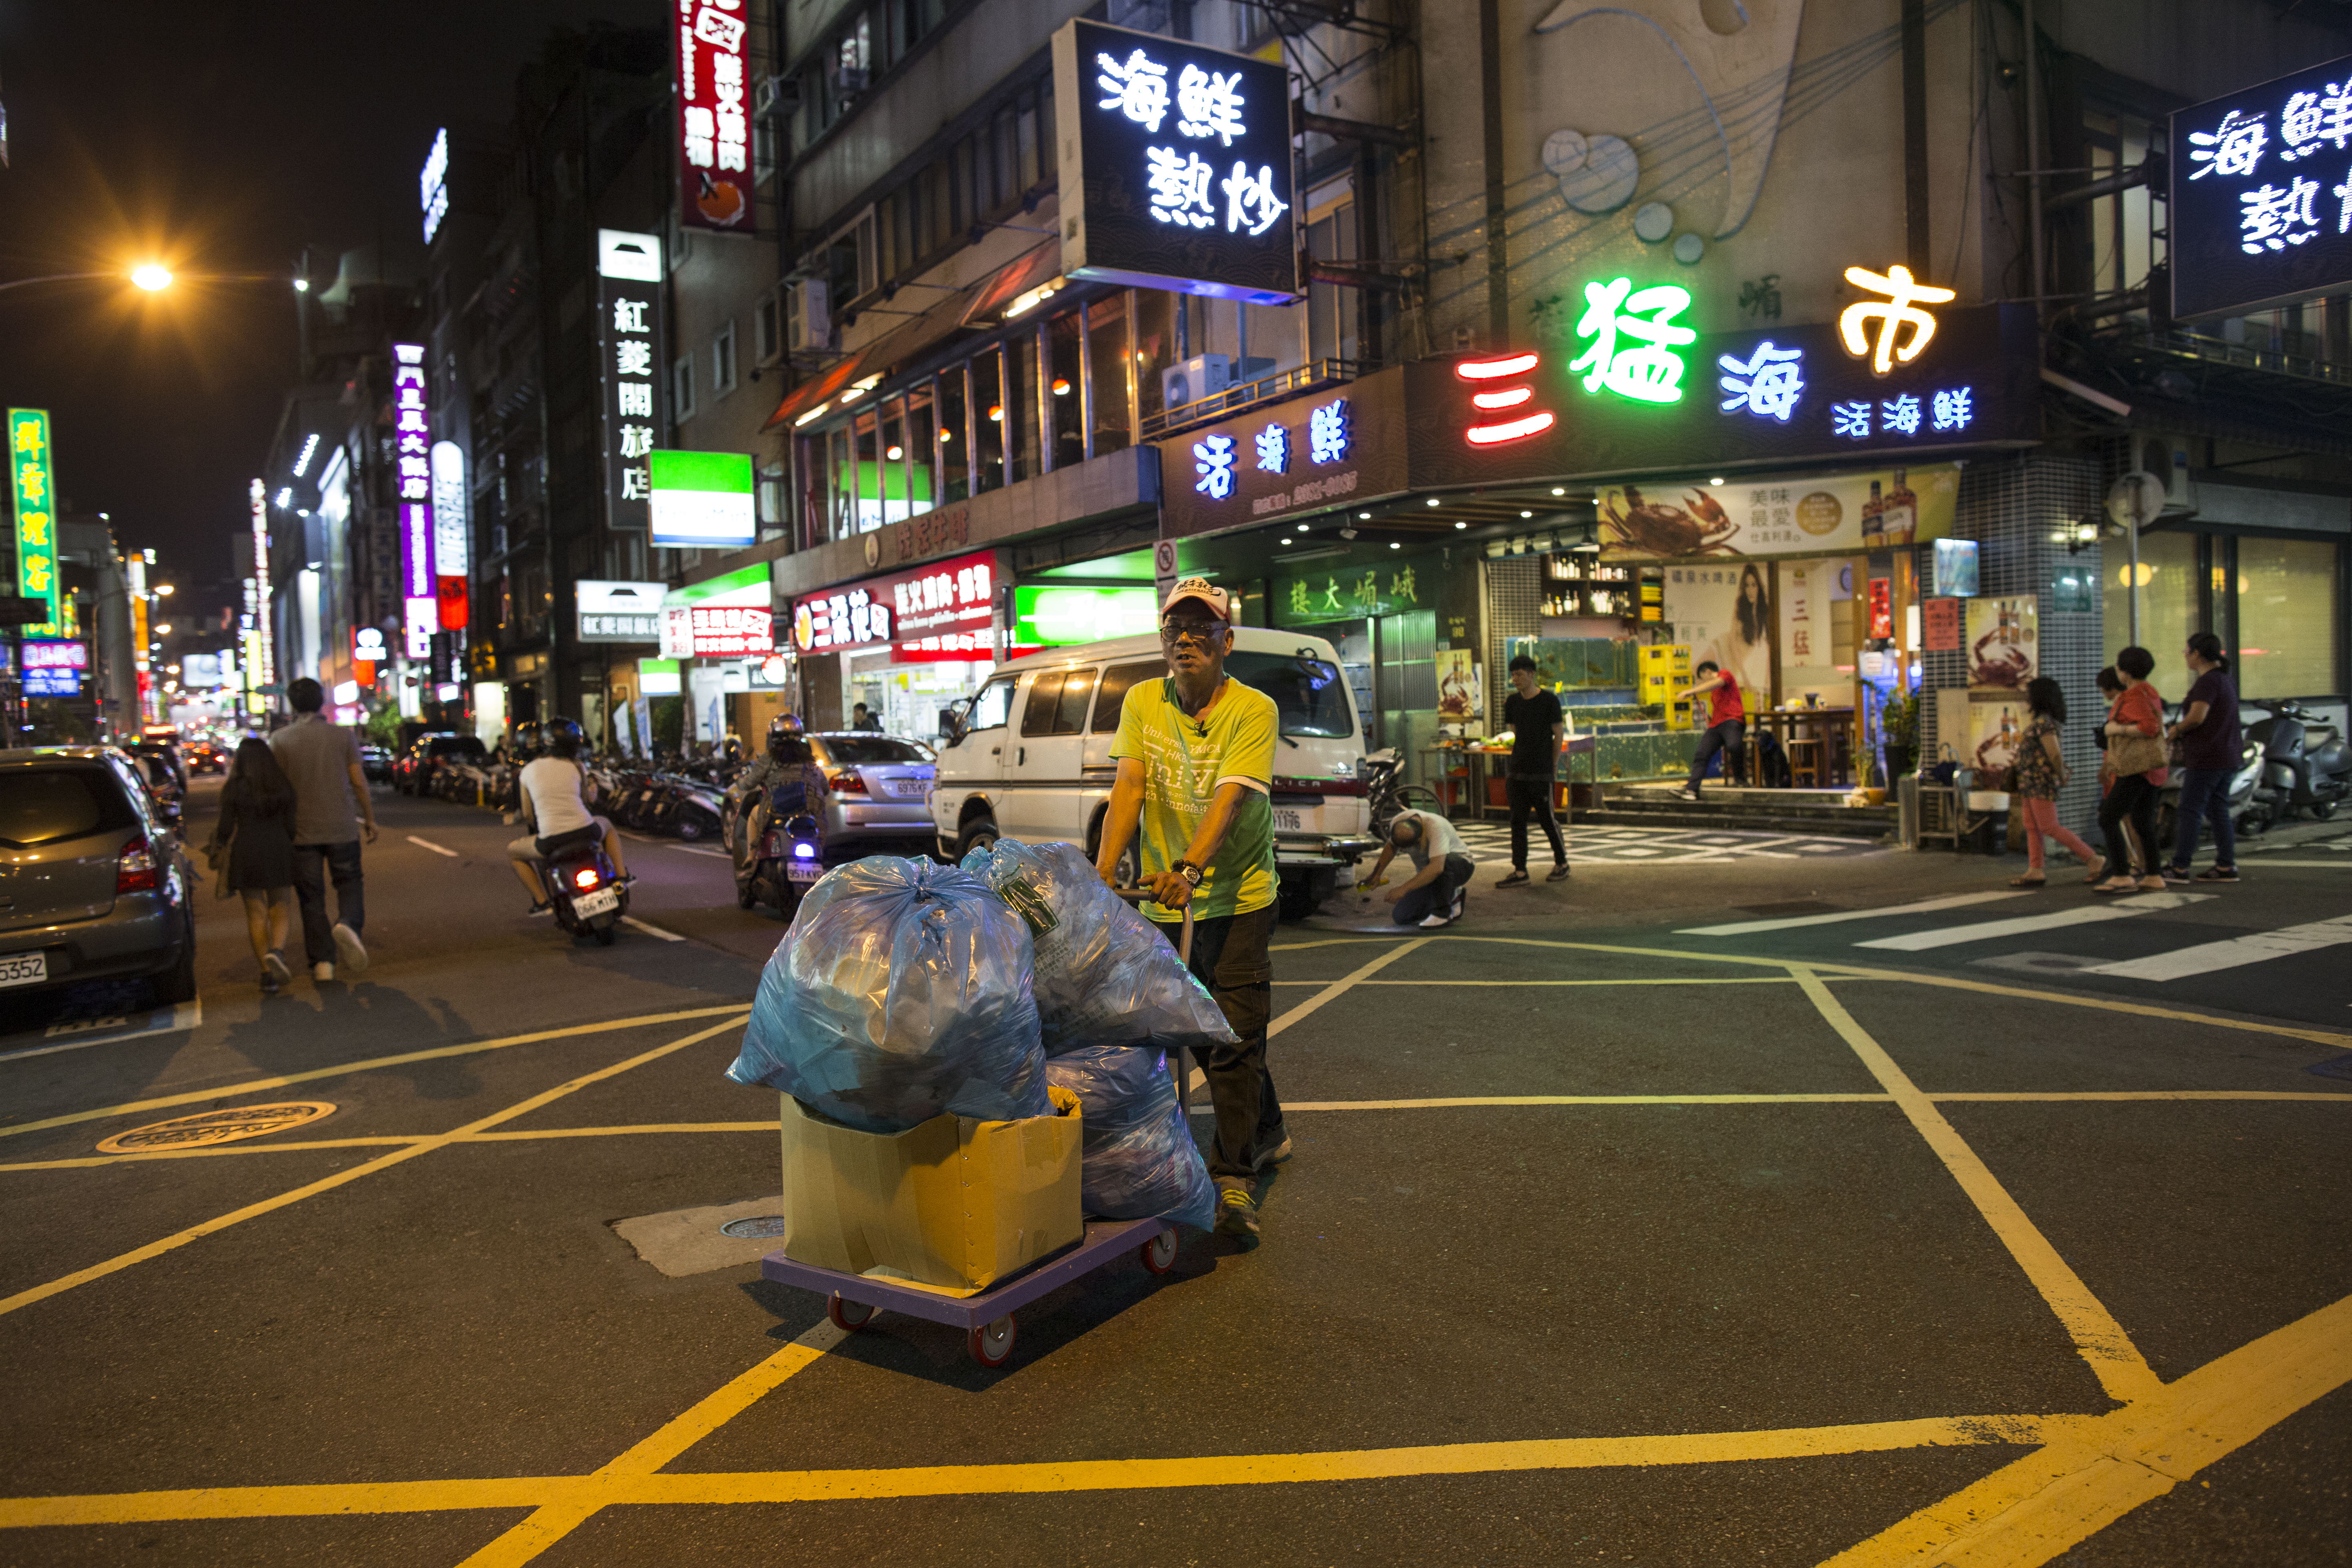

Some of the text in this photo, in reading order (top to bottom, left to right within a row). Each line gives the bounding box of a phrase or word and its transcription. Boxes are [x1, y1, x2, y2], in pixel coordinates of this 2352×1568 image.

[1098, 49, 1246, 147] 海鮮
[1147, 146, 1289, 236] 熱炒
[614, 297, 654, 500] 紅菱閣旅店
[1833, 387, 1973, 437] 活海鮮
[1193, 399, 1346, 499] 活海鮮
[1750, 488, 1790, 507] 美味
[1751, 507, 1791, 527] 最愛
[1791, 599, 1810, 667] 三猛
[1143, 724, 1221, 754] Universi YMCA
[1165, 797, 1211, 815] innofait
